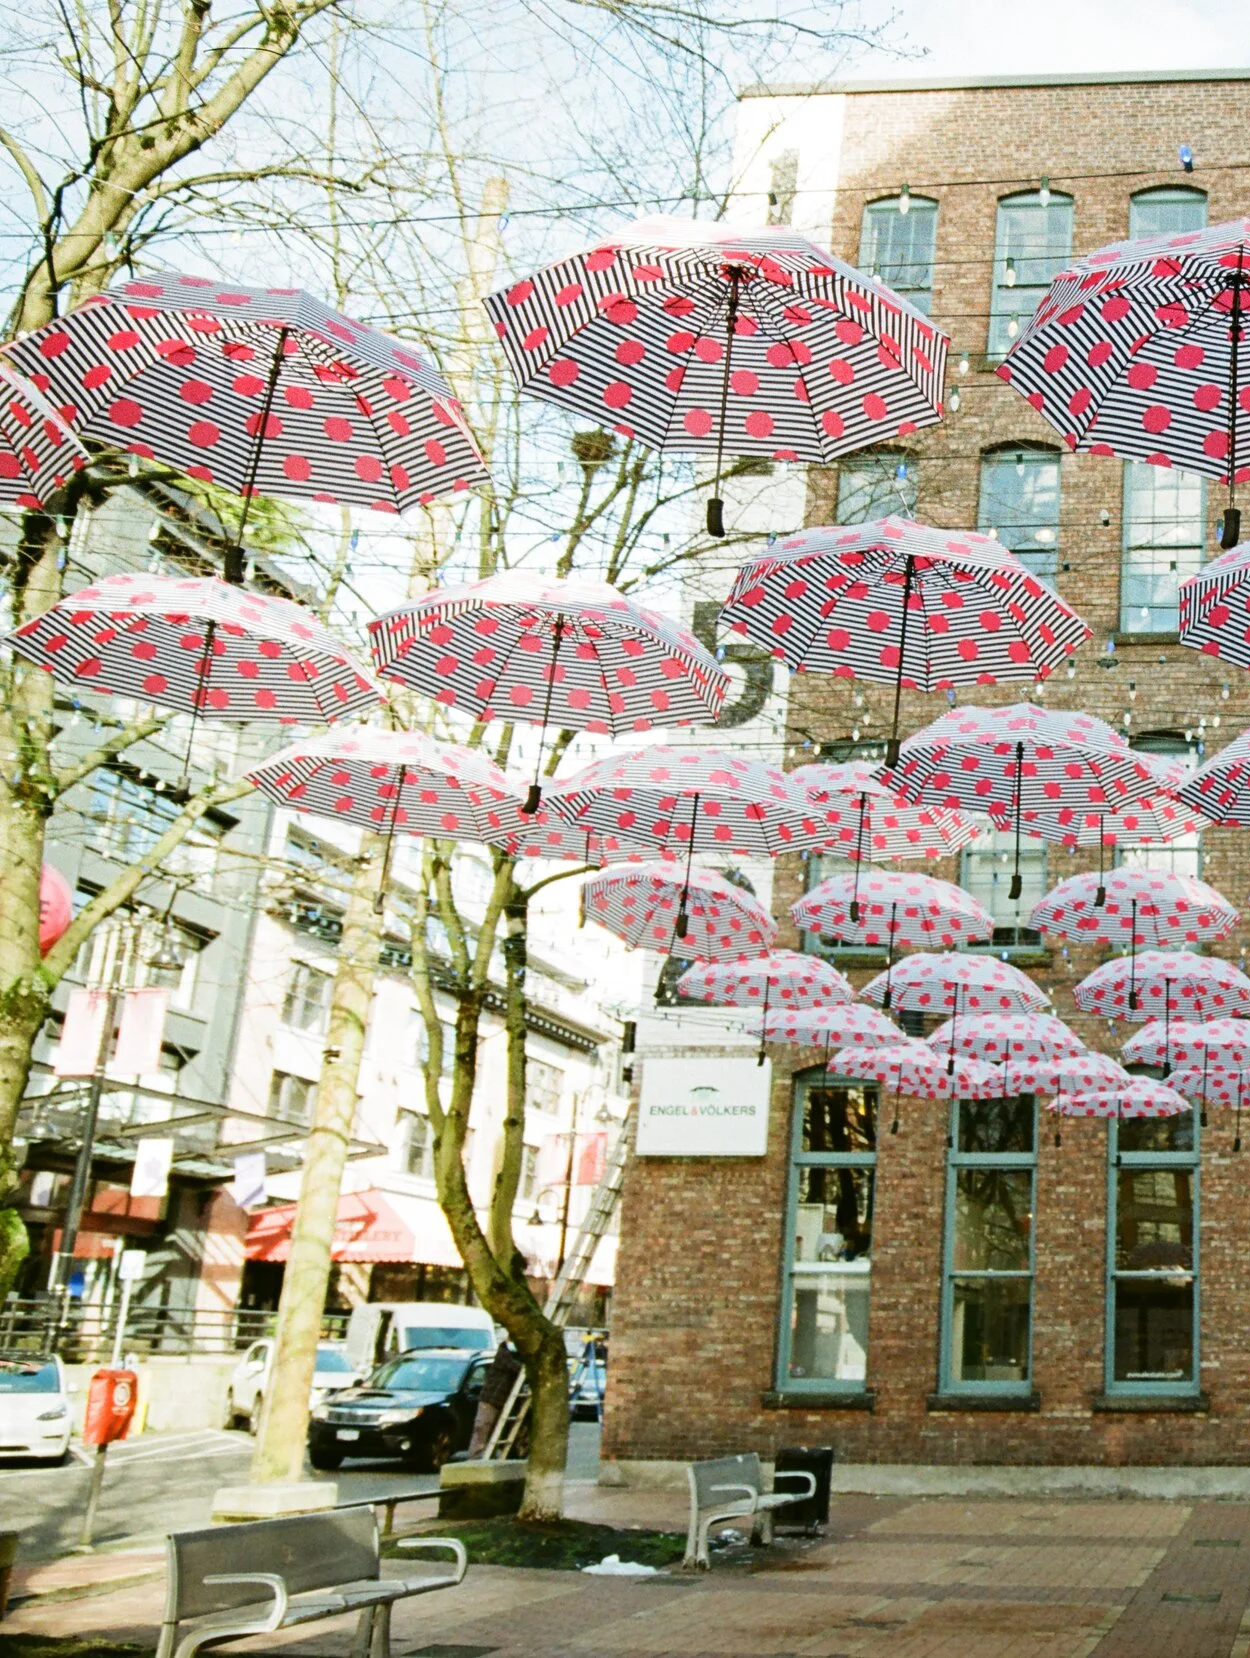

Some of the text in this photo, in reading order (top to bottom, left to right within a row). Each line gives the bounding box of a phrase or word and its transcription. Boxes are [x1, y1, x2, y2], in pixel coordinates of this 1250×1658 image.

[649, 1103, 757, 1117] ENGEL & VÖLKERS
